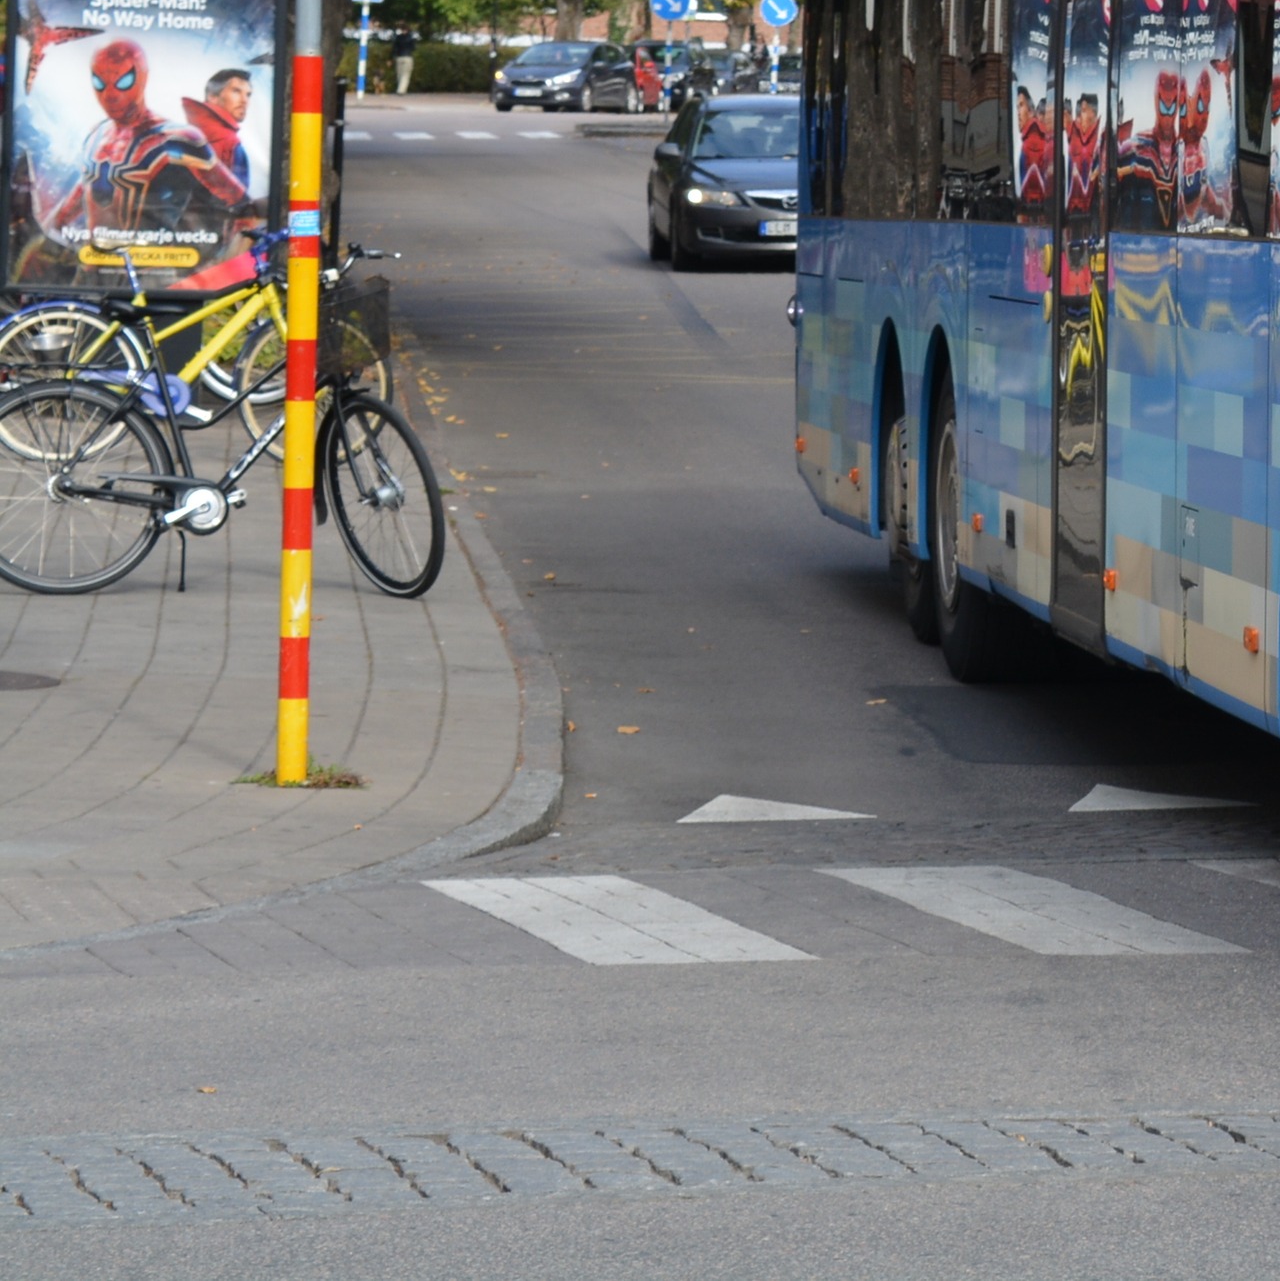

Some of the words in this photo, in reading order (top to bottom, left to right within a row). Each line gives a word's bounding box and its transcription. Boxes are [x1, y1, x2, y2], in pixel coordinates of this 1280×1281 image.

[82, 9, 112, 27] No
[114, 10, 155, 30] Way
[158, 12, 215, 30] Home
[61, 226, 91, 242] Nya
[93, 226, 136, 240] filmer
[136, 228, 174, 244] varje
[176, 230, 218, 244] vecka
